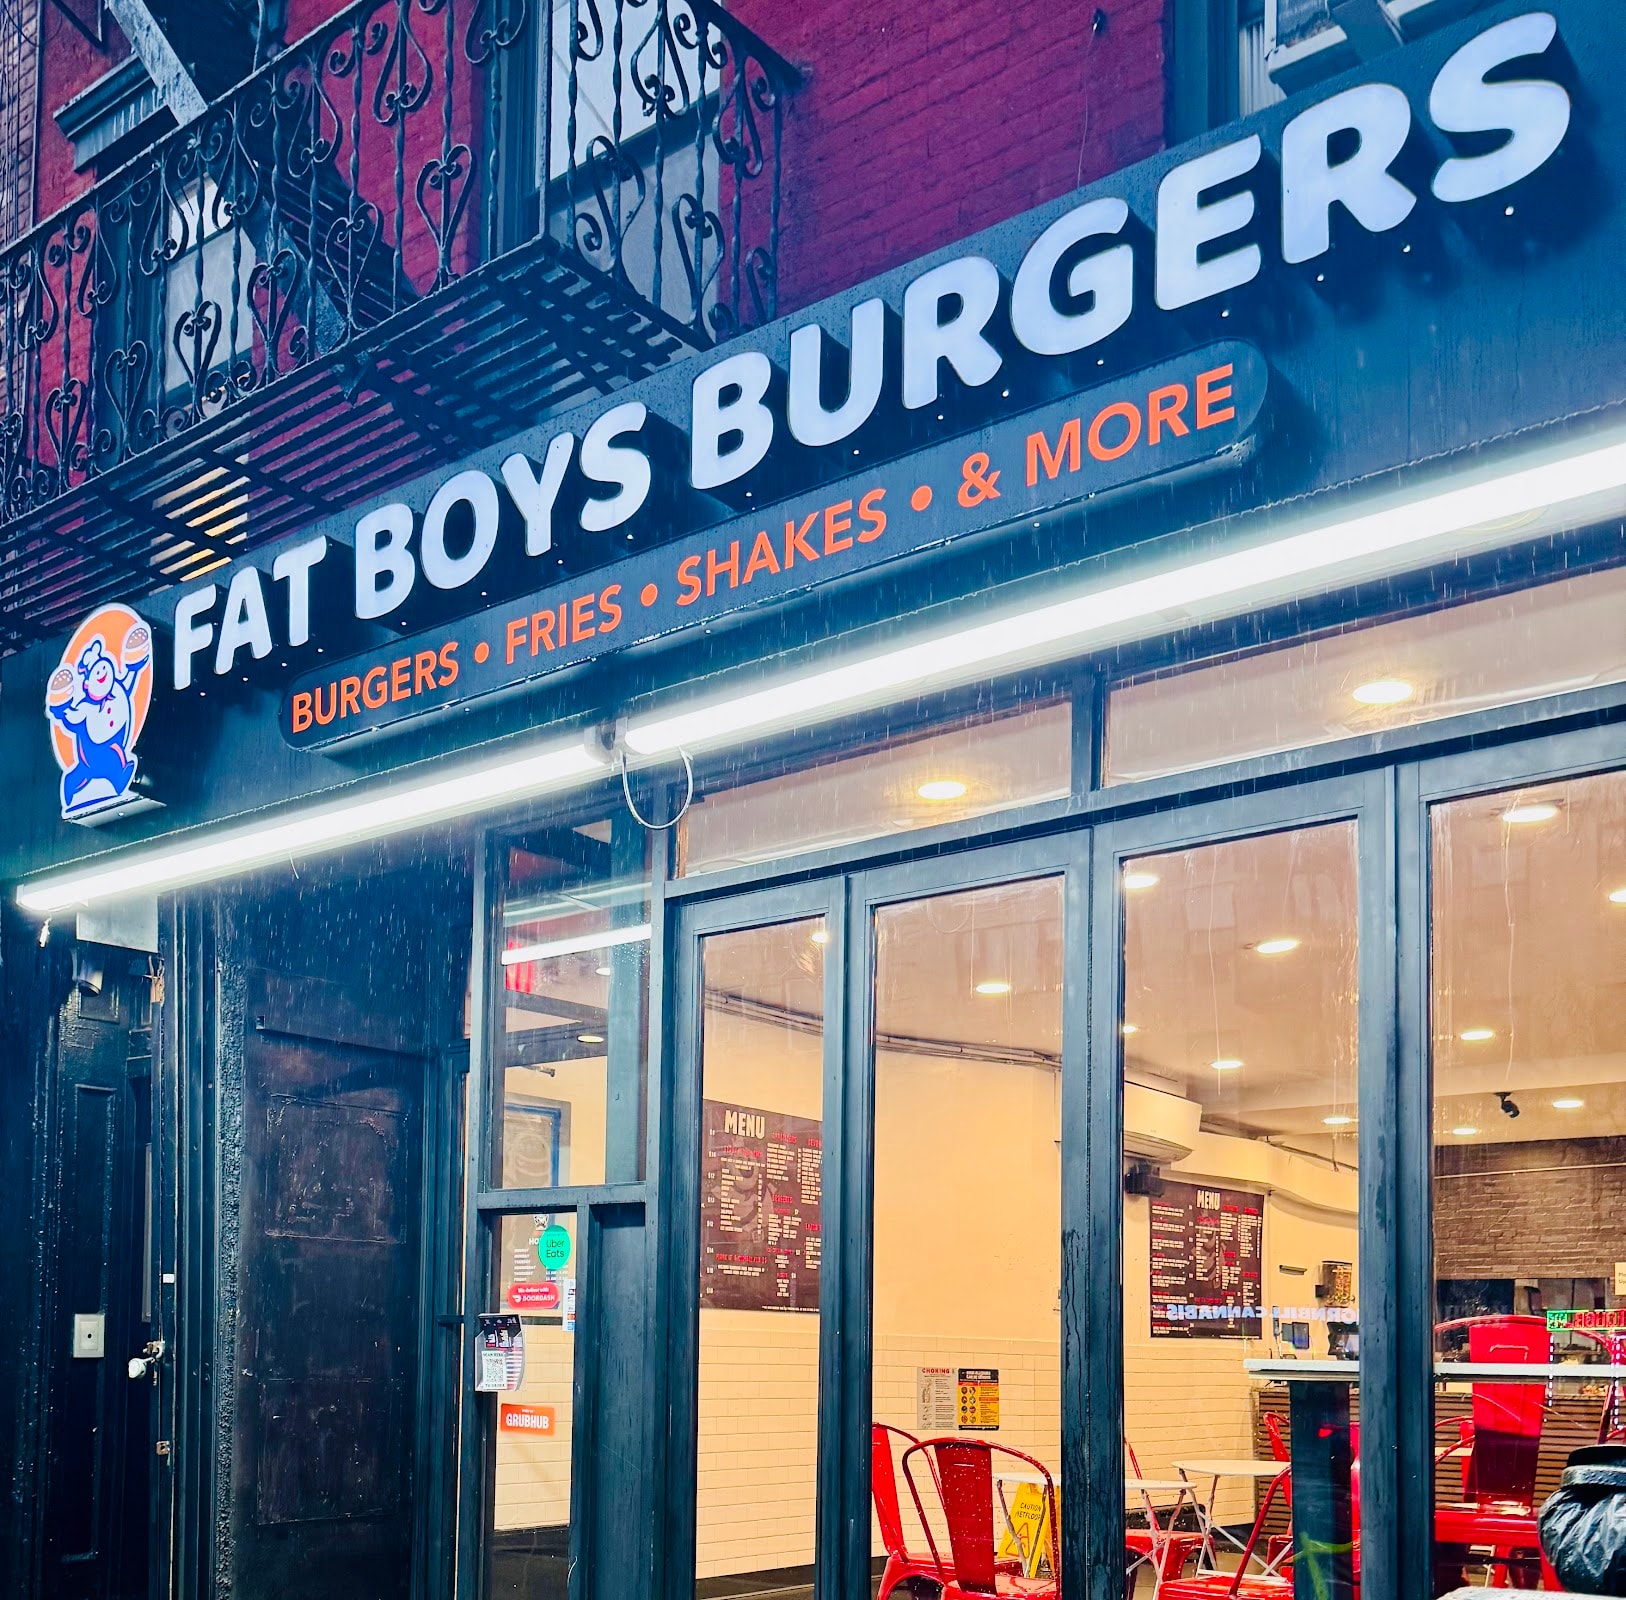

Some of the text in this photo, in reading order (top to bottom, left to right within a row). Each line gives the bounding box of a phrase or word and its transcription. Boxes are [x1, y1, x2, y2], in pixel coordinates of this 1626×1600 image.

[173, 11, 1571, 690] FAT BOYS BURGERS
[291, 363, 1236, 734] BURGERS FRIES SHAKES & MORE
[724, 1110, 766, 1139] MENU
[1196, 1189, 1221, 1211] MENU
[528, 1237, 541, 1246] HO
[546, 1239, 565, 1248] Uber
[546, 1249, 565, 1258] Eats
[522, 1294, 555, 1302] DOORDASH
[505, 1412, 550, 1430] GRUBHUB
[1020, 1502, 1041, 1512] CAUTION
